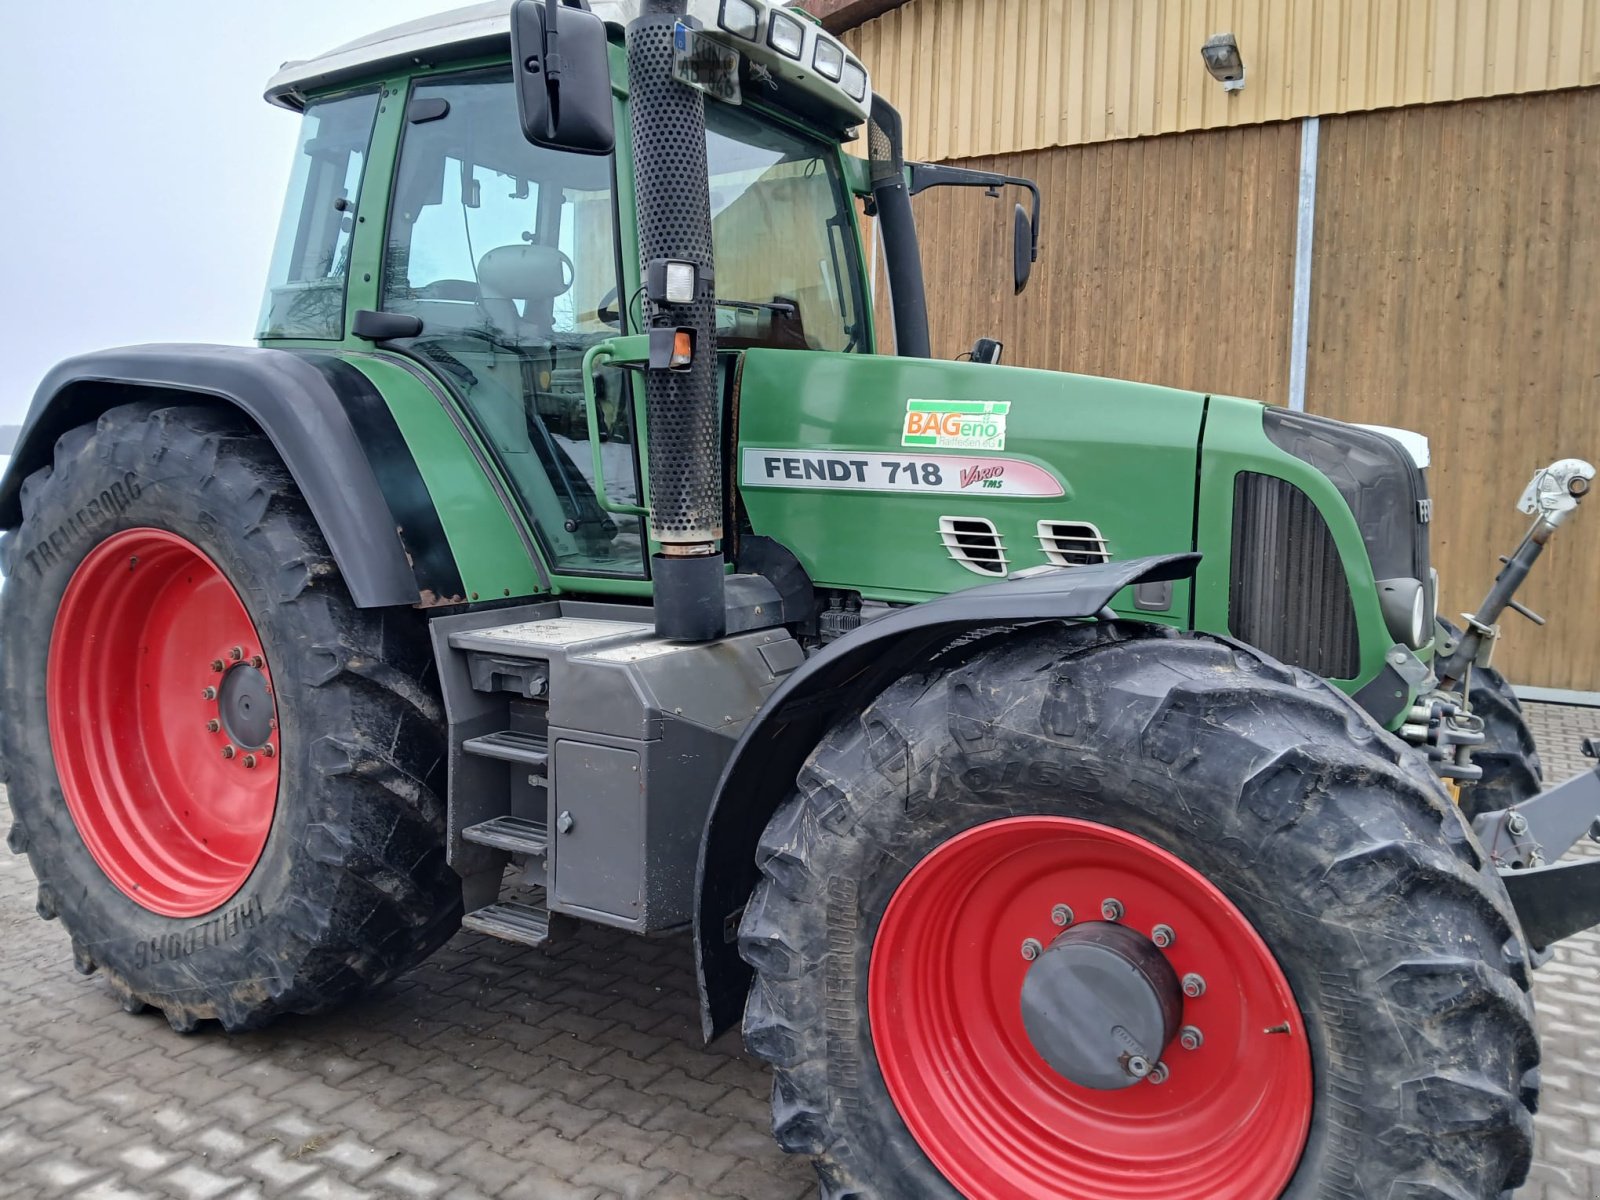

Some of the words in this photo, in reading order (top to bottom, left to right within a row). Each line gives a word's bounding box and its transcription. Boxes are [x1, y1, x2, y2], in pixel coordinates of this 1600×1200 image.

[763, 457, 869, 483] FENDT
[881, 461, 943, 486] 718
[982, 479, 1003, 489] TMS
[24, 470, 143, 577] TRELLEBORG
[134, 892, 269, 970] TRELLEBORG
